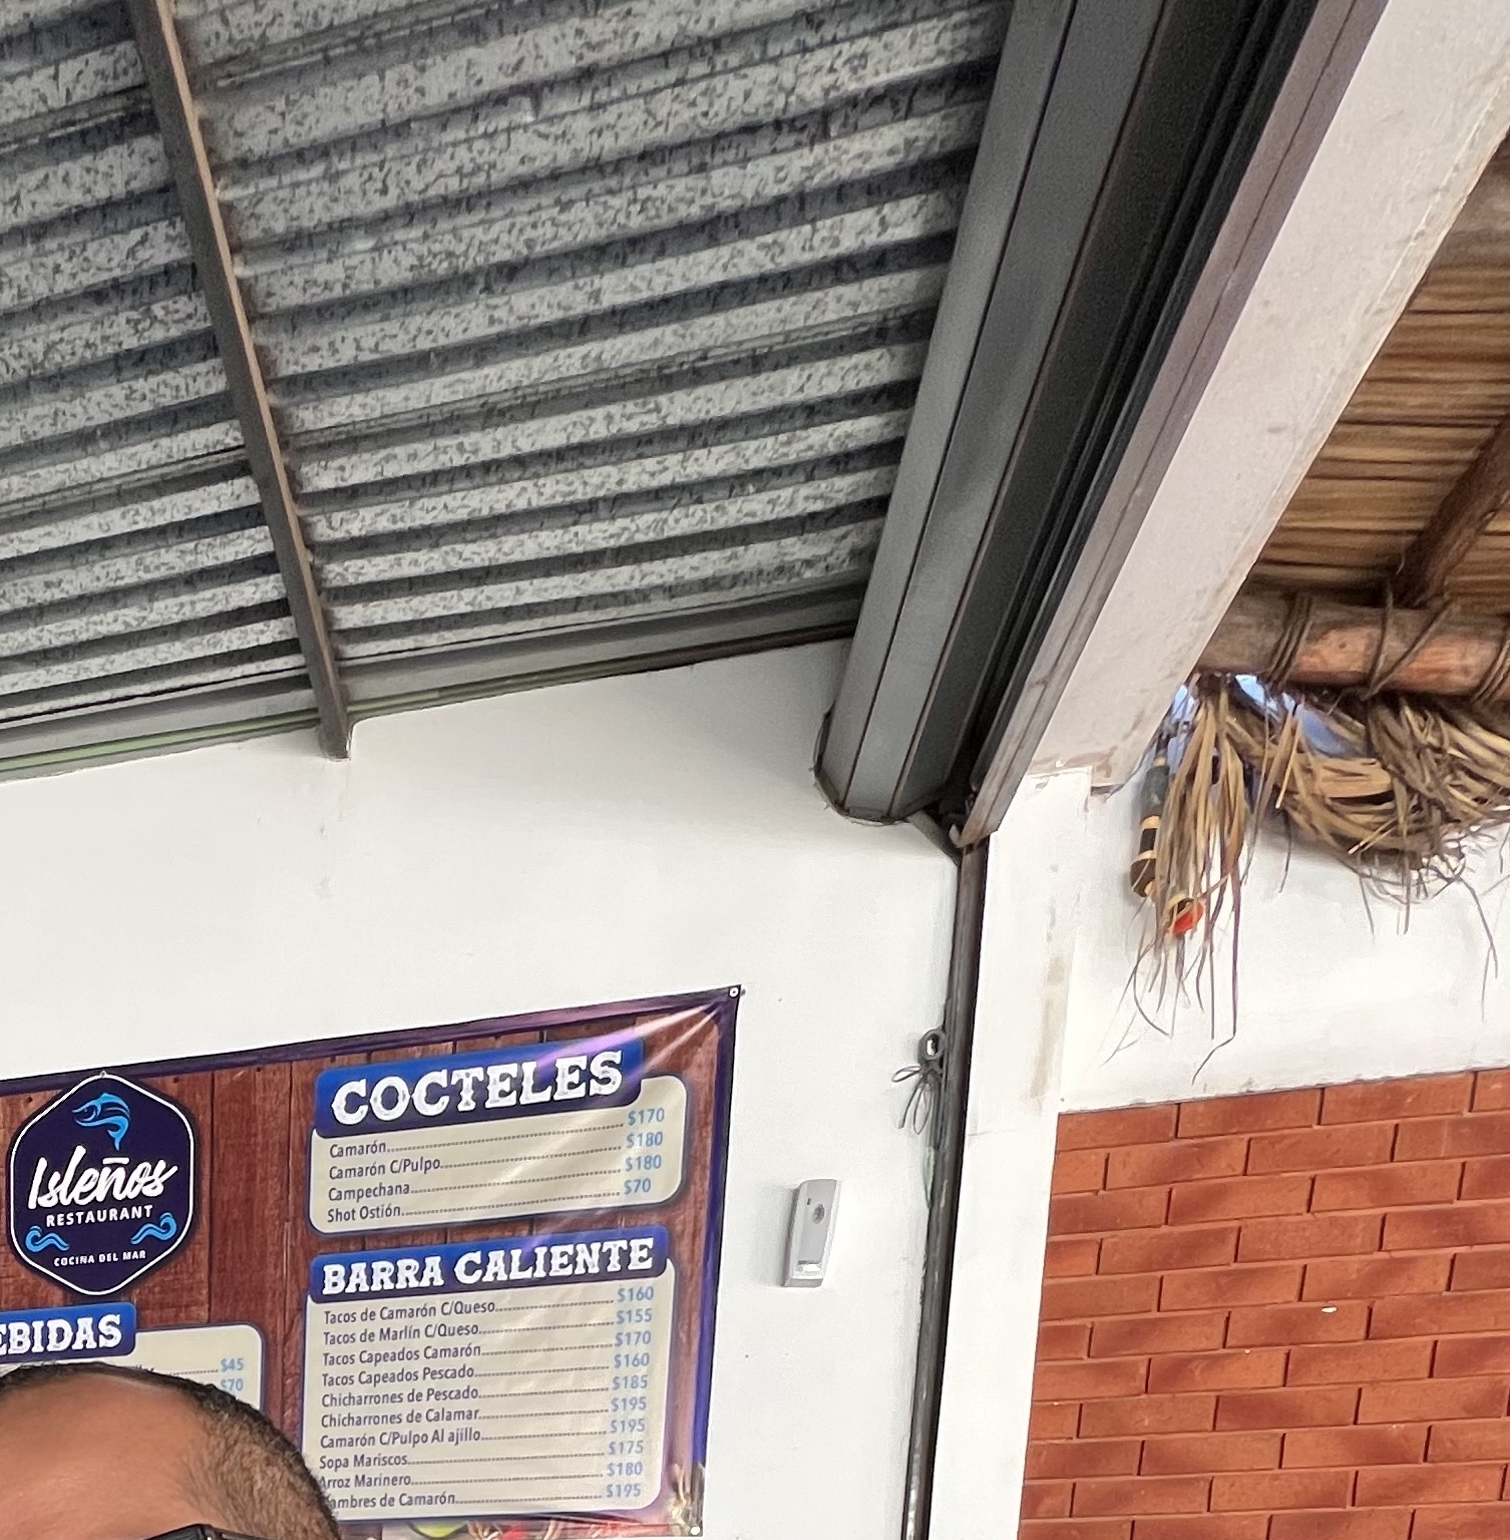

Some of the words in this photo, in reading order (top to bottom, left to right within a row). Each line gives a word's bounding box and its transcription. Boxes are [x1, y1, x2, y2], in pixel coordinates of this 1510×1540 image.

[331, 1050, 623, 1125] COCTELES
[330, 1140, 386, 1159] Camarón
[628, 1108, 665, 1126] $170
[329, 1161, 386, 1180] Camarón
[390, 1155, 441, 1177] C/Pulpo
[626, 1131, 664, 1149] $180
[27, 1145, 178, 1210] Isleños
[328, 1181, 410, 1203] Campechana
[625, 1154, 662, 1173] $180
[46, 1204, 153, 1228] RESTAURANT
[327, 1207, 356, 1224] Shot
[359, 1203, 401, 1220] Ostión
[623, 1178, 651, 1195] $70
[54, 1254, 95, 1267] COCINA
[99, 1252, 118, 1263] DEL
[122, 1250, 146, 1261] MAR
[322, 1256, 444, 1295] BARRA
[453, 1237, 654, 1284] CALIENTE
[324, 1310, 356, 1324] Tacos
[360, 1308, 376, 1322] de
[379, 1303, 437, 1321] Camarón
[441, 1301, 495, 1316] C/Queso
[617, 1286, 654, 1301] $160
[324, 1331, 356, 1345] Tacos
[359, 1328, 375, 1342] de
[379, 1325, 420, 1341] Marlín
[424, 1323, 479, 1338] C/Queso
[616, 1308, 652, 1323] $155
[220, 1358, 244, 1372] $45
[323, 1352, 355, 1366] Tacos
[359, 1346, 420, 1367] Capeados
[423, 1343, 481, 1360] Camarón
[615, 1331, 651, 1347] $170
[322, 1373, 354, 1387] Tacos
[358, 1367, 419, 1388] Capeados
[422, 1364, 475, 1381] Pescado
[613, 1352, 650, 1369] $160
[321, 1388, 403, 1408] Chicharrones
[407, 1389, 423, 1403] de
[426, 1385, 479, 1402] Pescado
[612, 1375, 648, 1390] $185
[321, 1409, 403, 1429] Chicharrones
[406, 1409, 422, 1423] de
[425, 1405, 479, 1422] Calamar
[611, 1396, 647, 1412] $195
[320, 1432, 376, 1449] Camarón
[379, 1430, 427, 1448] C/Pulpo
[431, 1429, 445, 1443] Al
[448, 1427, 481, 1444] ajillo
[610, 1418, 646, 1434] $195
[319, 1455, 349, 1471] Sopa
[353, 1452, 408, 1467] Mariscos
[608, 1440, 644, 1455] $175
[319, 1476, 351, 1489] Arroz
[354, 1472, 411, 1488] Marinero
[607, 1462, 643, 1477] $180
[327, 1494, 376, 1509] ambres
[379, 1493, 395, 1507] de
[399, 1491, 455, 1506] Camarón
[606, 1482, 642, 1498] $195
